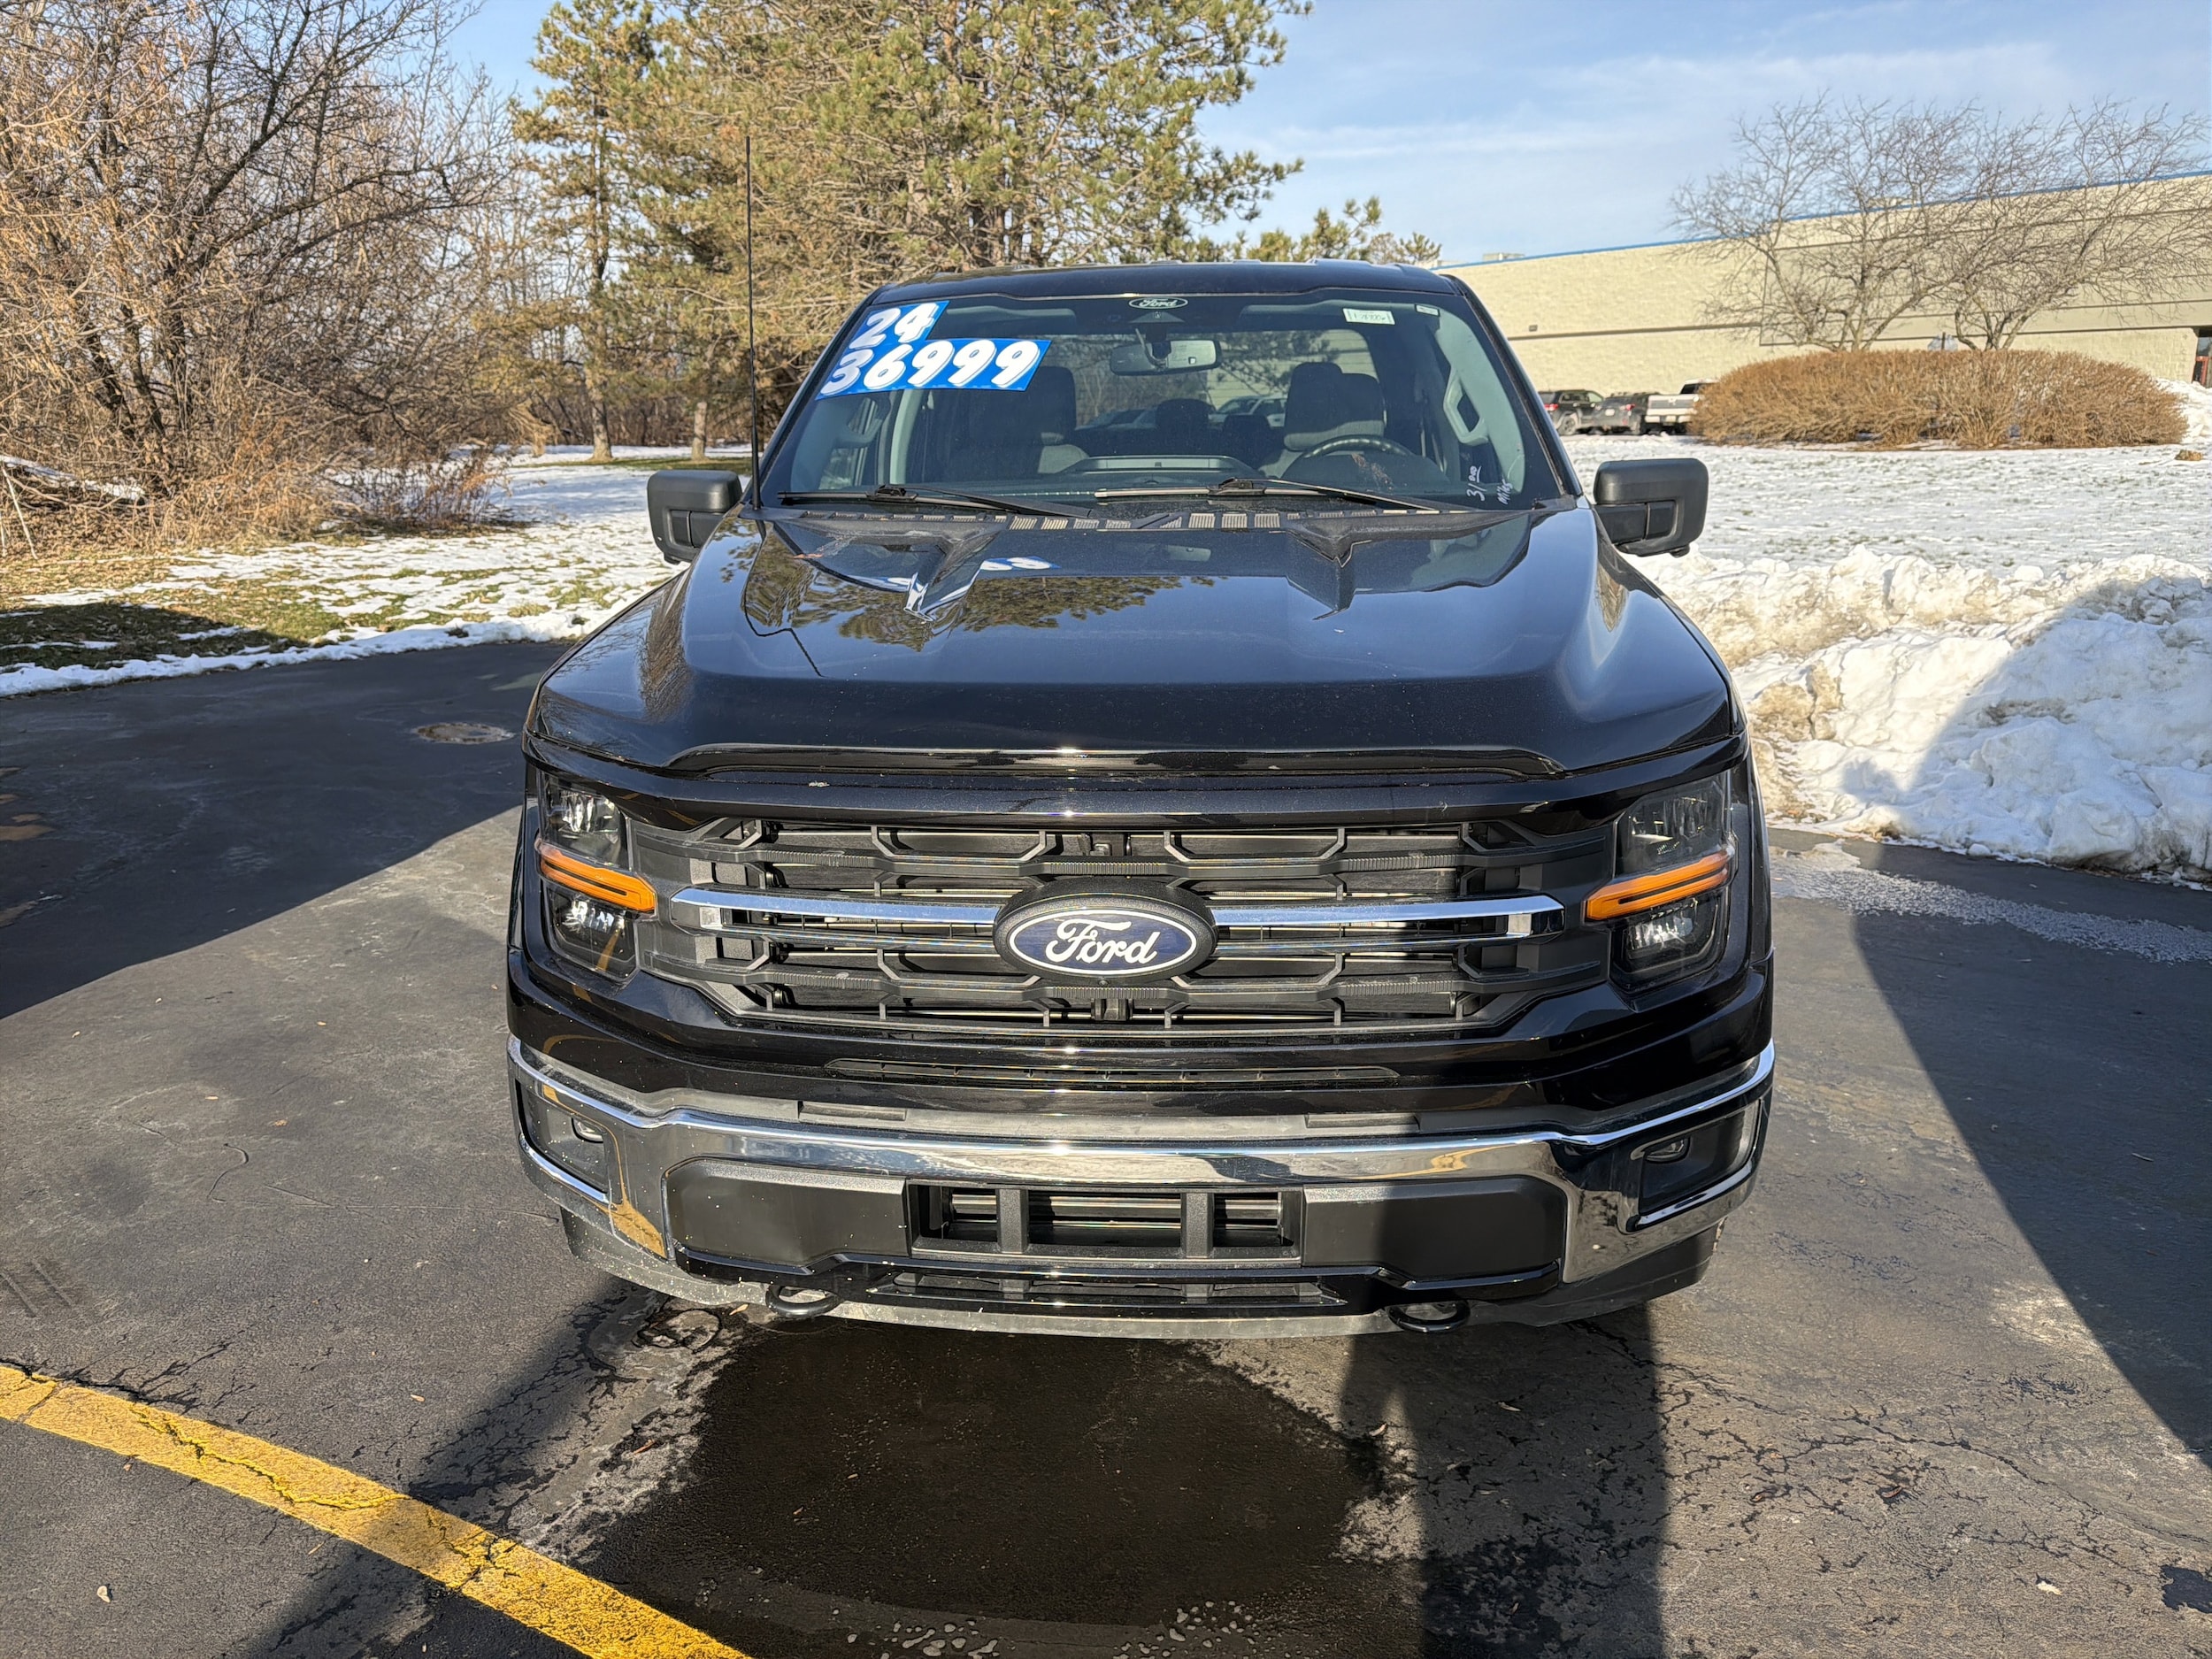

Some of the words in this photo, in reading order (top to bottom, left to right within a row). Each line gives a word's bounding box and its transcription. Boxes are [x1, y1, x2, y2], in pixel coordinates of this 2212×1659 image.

[849, 302, 939, 350] 24
[1139, 298, 1179, 308] Ford
[819, 339, 1041, 396] 36999
[1045, 918, 1161, 964] Ford
